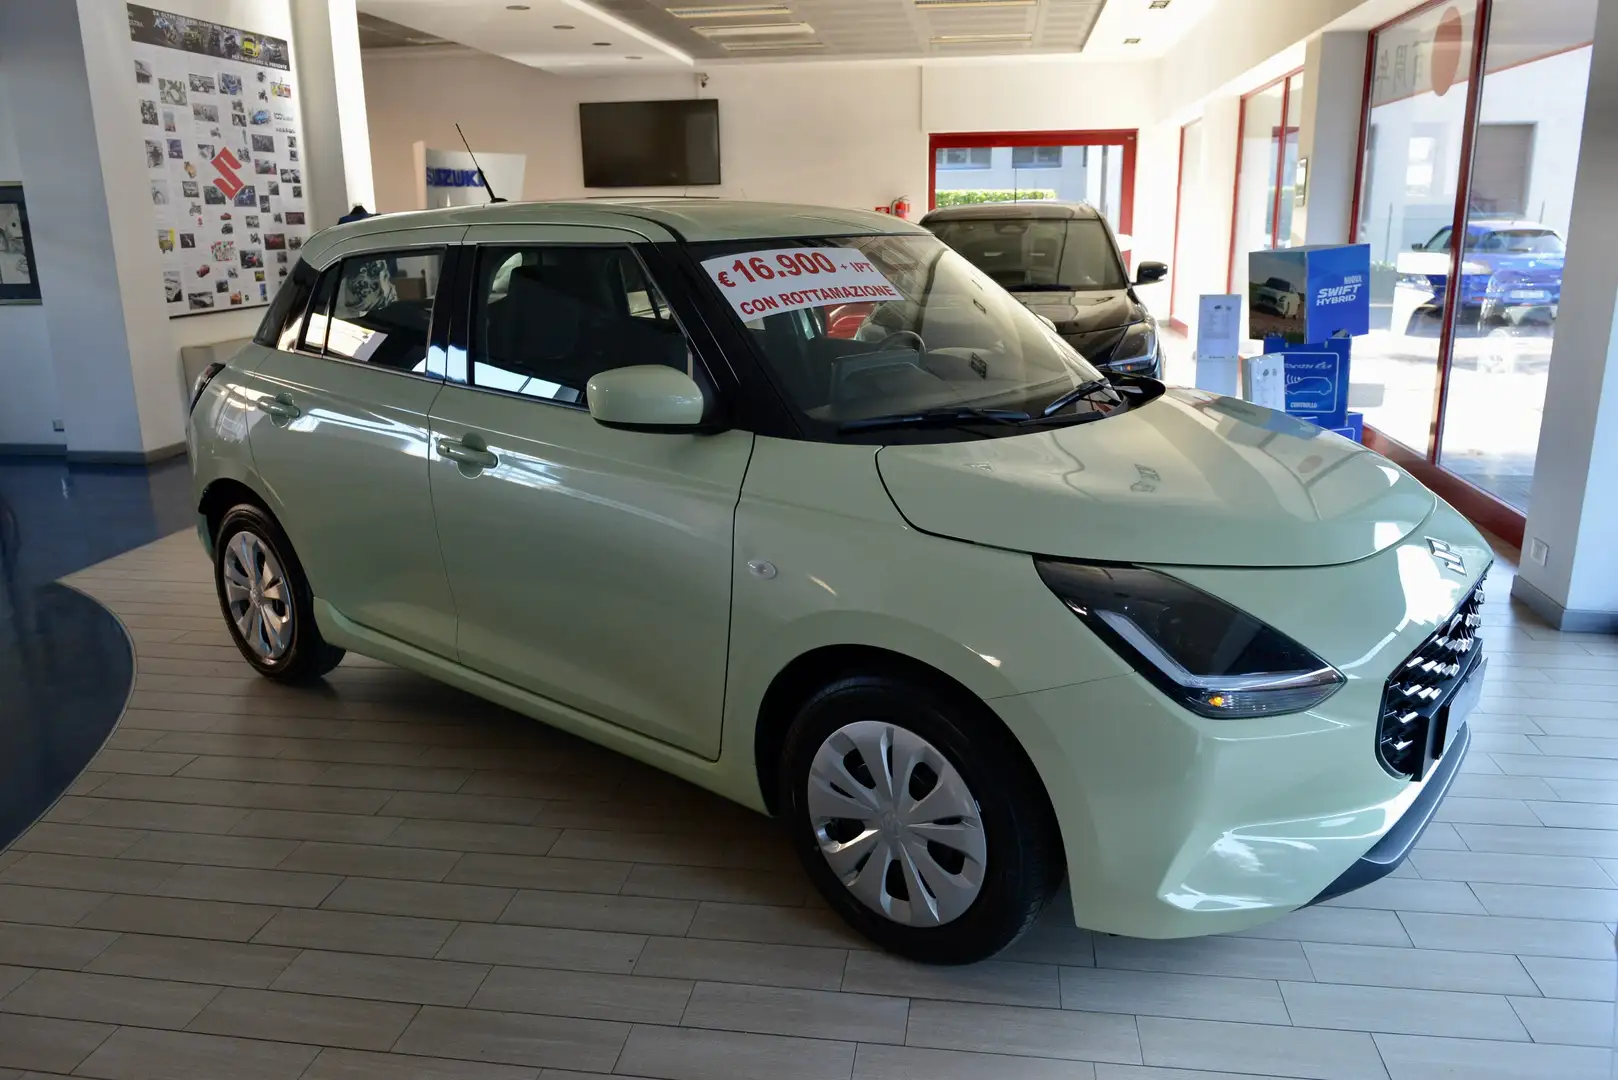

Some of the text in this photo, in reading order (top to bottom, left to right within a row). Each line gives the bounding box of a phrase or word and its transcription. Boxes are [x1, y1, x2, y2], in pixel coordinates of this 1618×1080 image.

[851, 261, 875, 273] IPT
[1317, 283, 1362, 299] SWIFT
[740, 285, 897, 315] CON ROTTAMAZIONE
[1315, 294, 1356, 307] HYBRID
